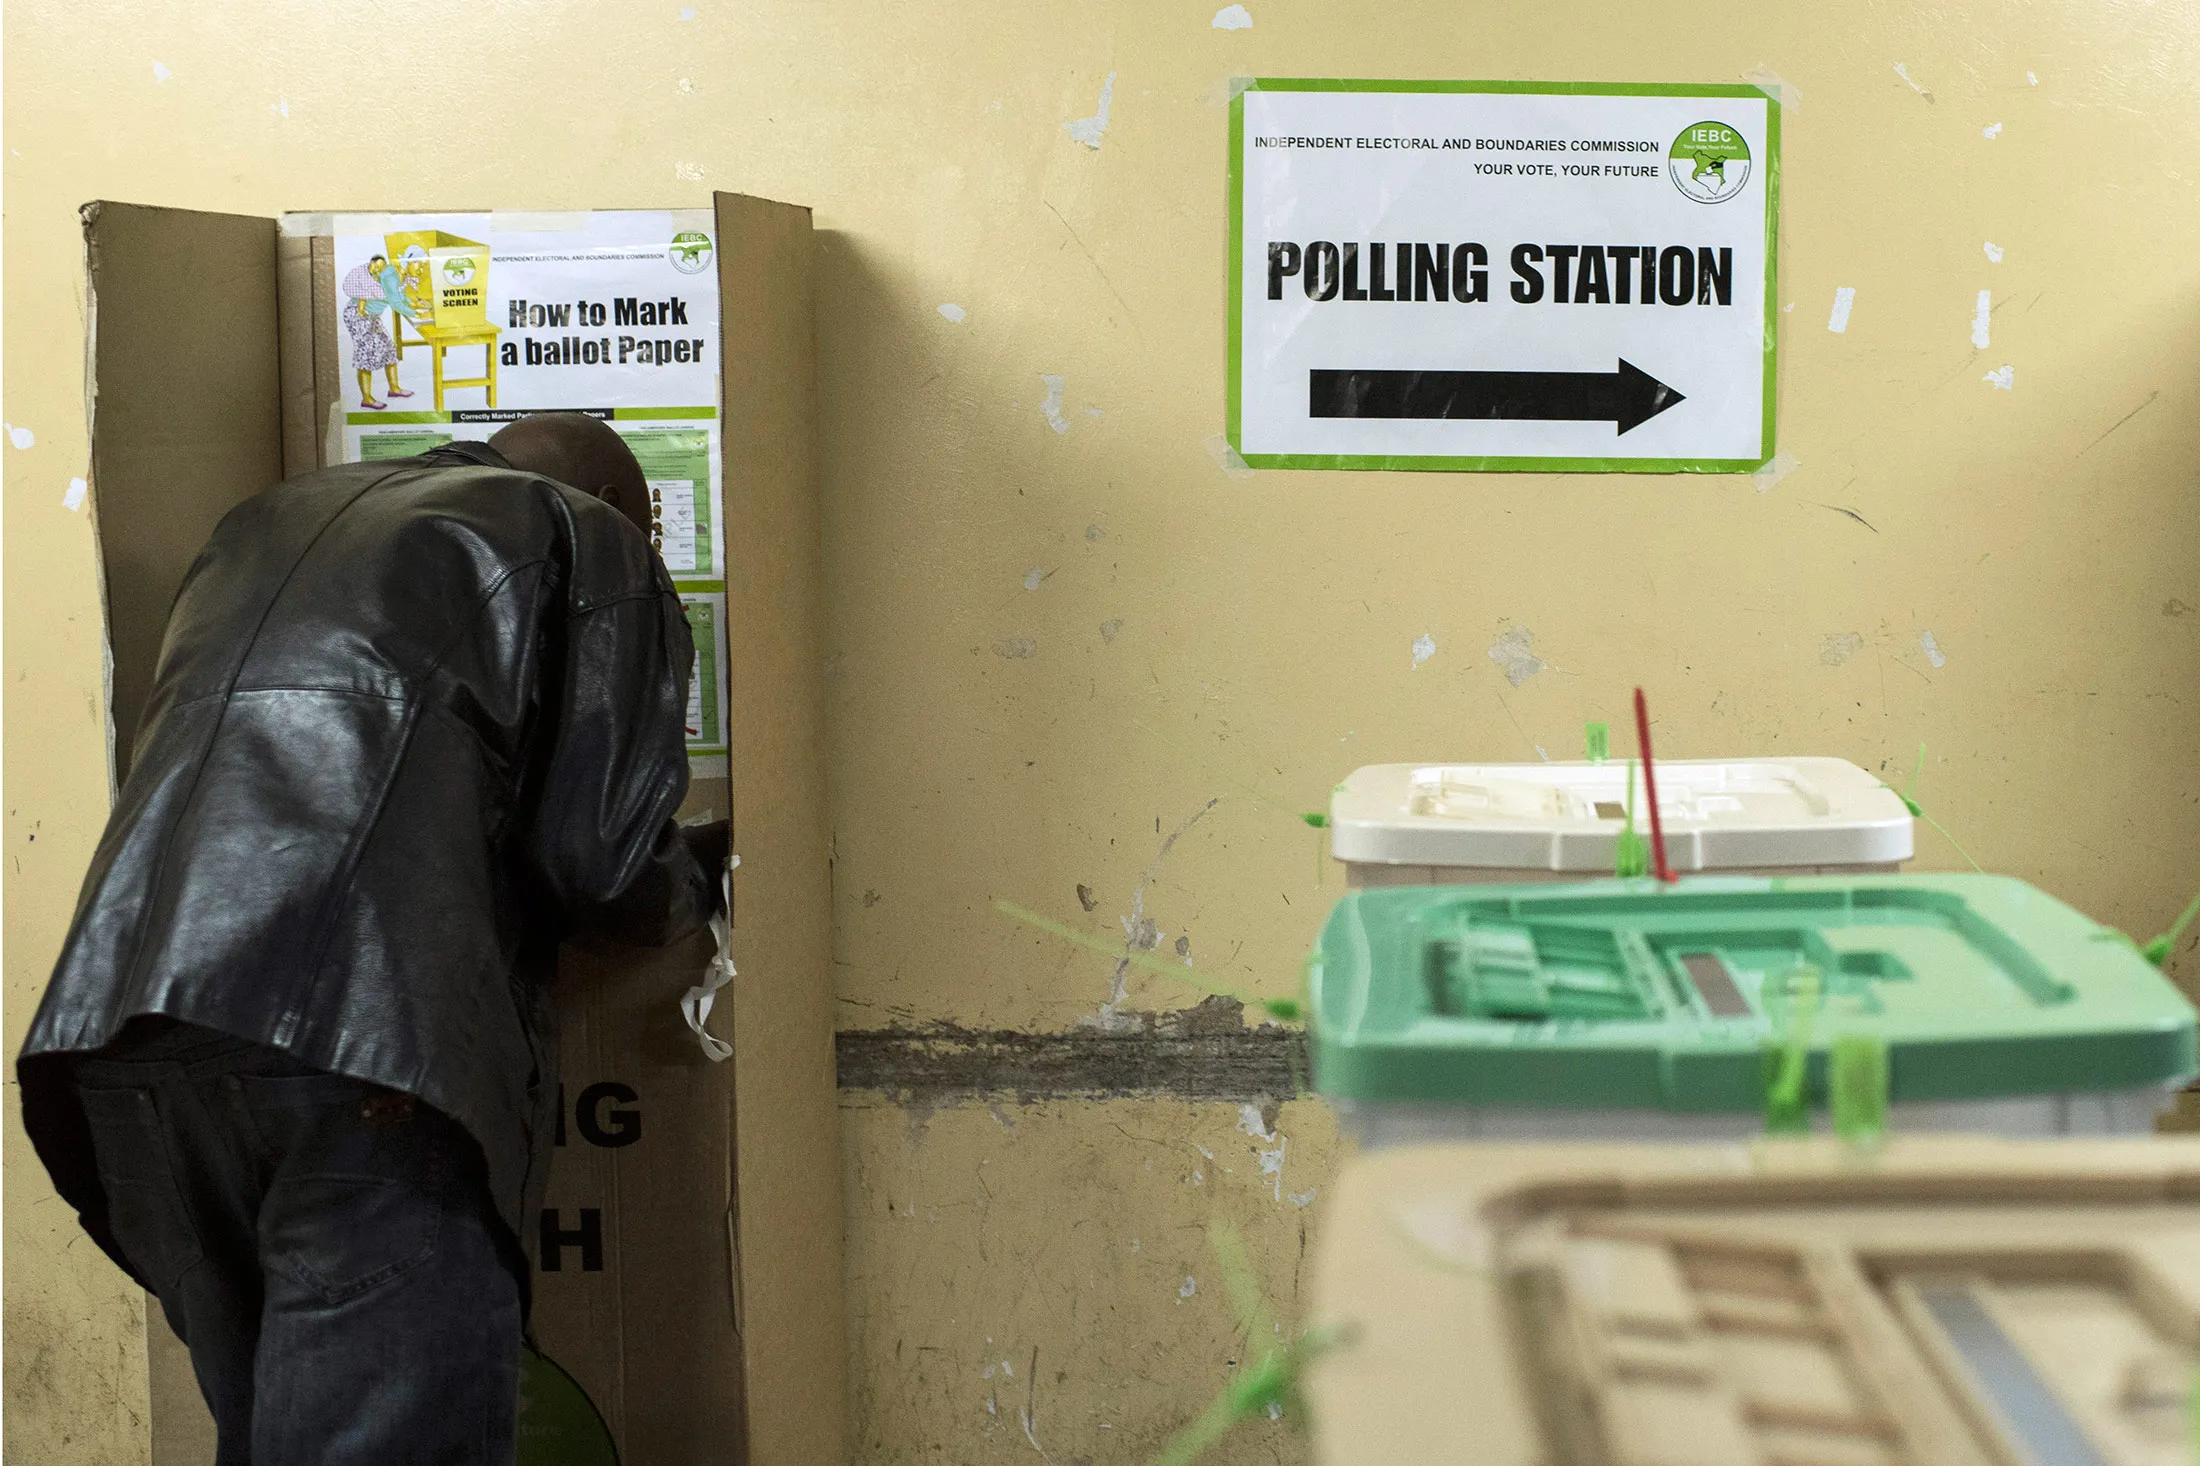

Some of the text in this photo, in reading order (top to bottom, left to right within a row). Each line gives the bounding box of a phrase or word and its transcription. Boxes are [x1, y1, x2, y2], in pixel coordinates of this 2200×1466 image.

[1692, 129, 1732, 143] IEBC
[1255, 136, 1659, 153] INDEPENDENT ELECTORAL AND BOUNDARIES COMMISSION
[1473, 163, 1513, 175] YOUR
[1516, 164, 1558, 177] VOTE,
[1561, 164, 1600, 176] YOUR
[1604, 165, 1659, 178] FUTURE
[680, 234, 703, 242] IEBC
[1267, 241, 1733, 306] POLLING STATION
[442, 288, 478, 297] VOTING
[442, 298, 479, 307] SCREEN
[509, 296, 689, 328] How to Mark
[501, 335, 705, 367] a ballot Paper
[460, 413, 490, 421] Correctly
[491, 412, 516, 420] Marked
